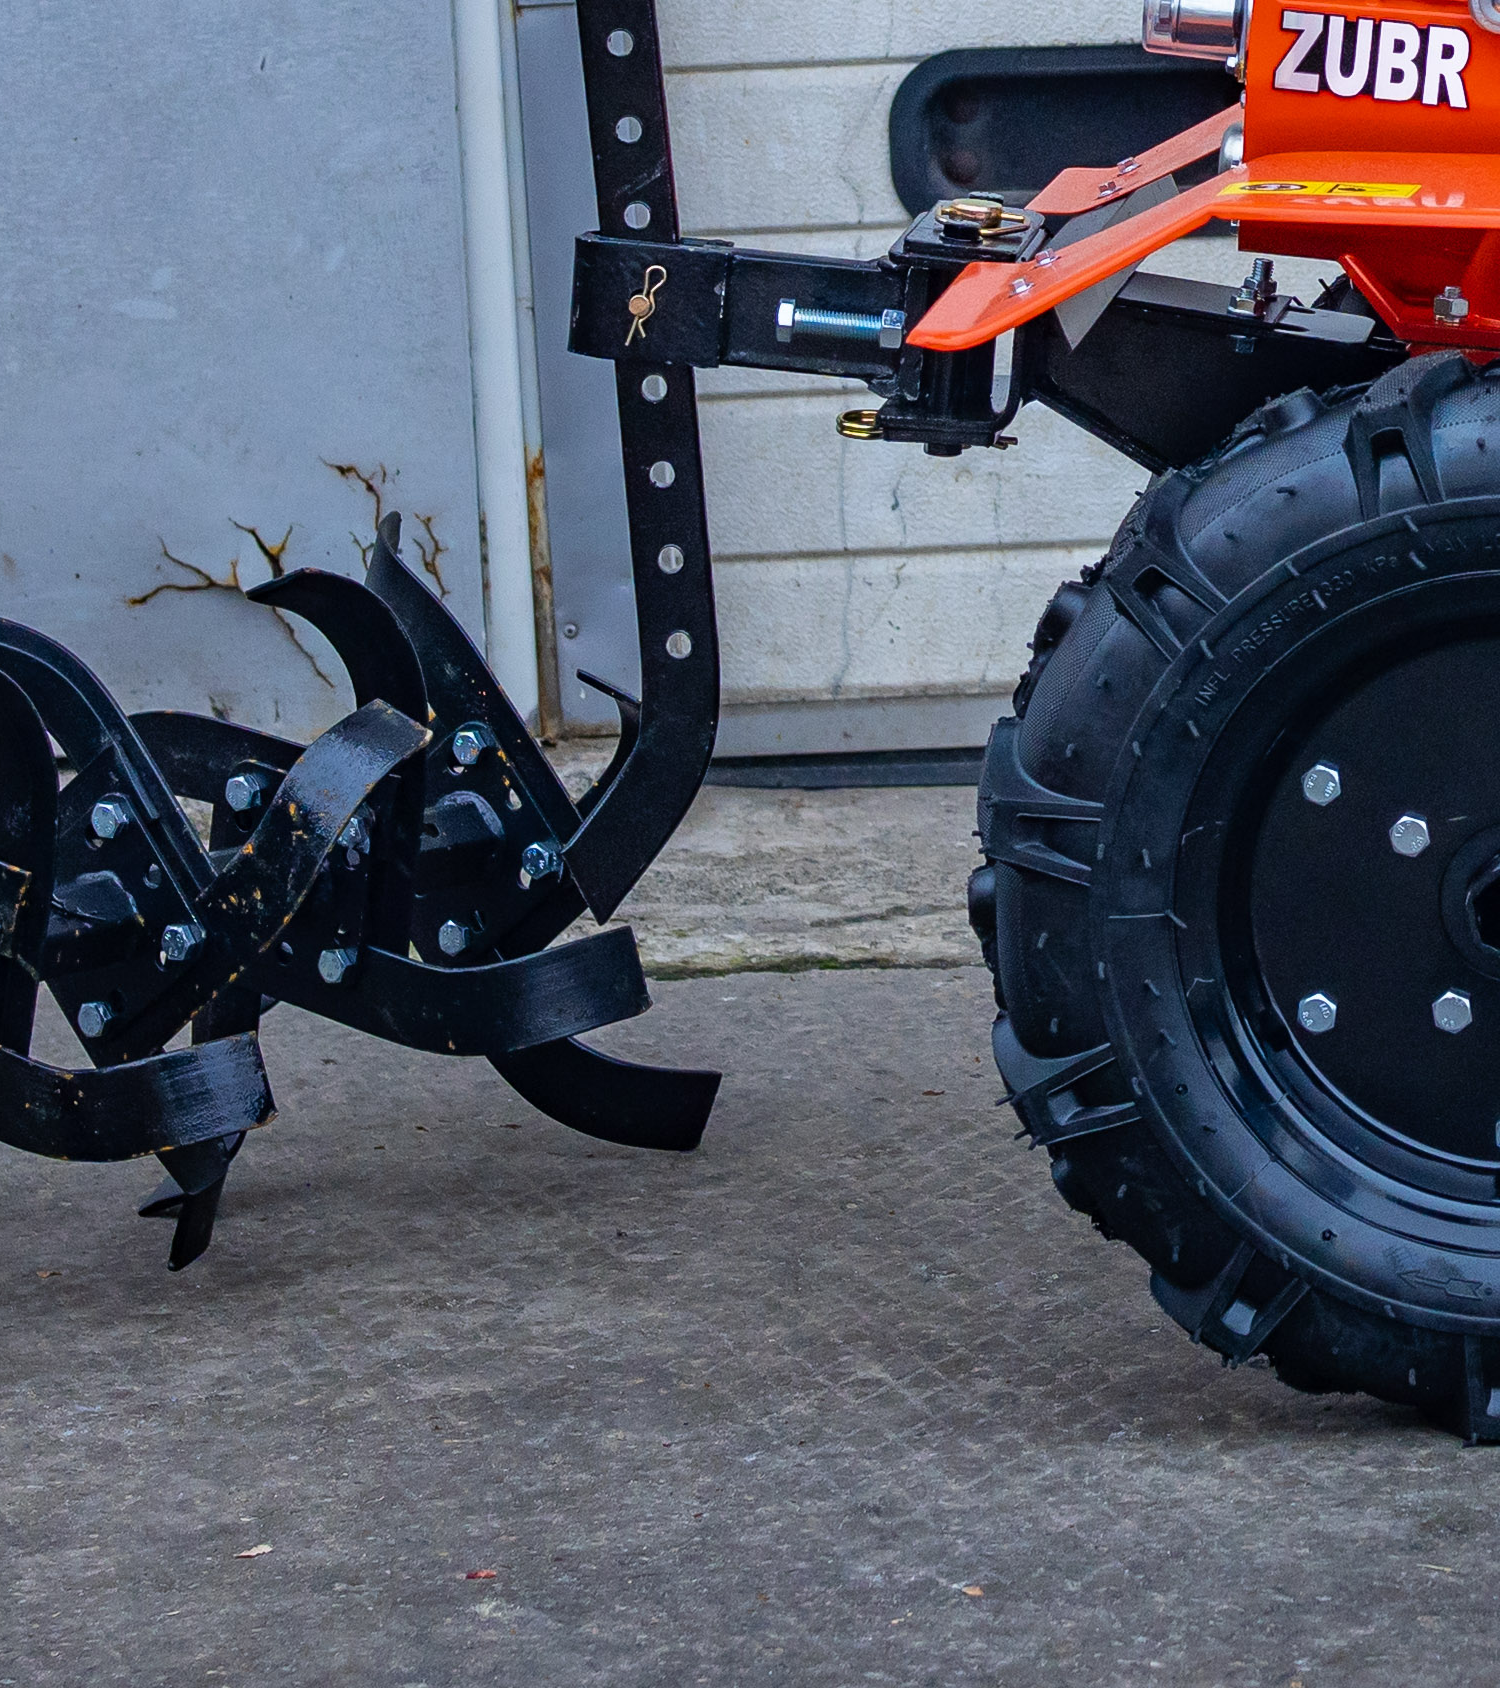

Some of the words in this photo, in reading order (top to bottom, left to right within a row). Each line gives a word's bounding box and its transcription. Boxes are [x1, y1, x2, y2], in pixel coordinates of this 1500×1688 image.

[1273, 11, 1470, 109] ZUBR
[1194, 670, 1231, 708] INFL
[1230, 591, 1315, 664] PRESSURE
